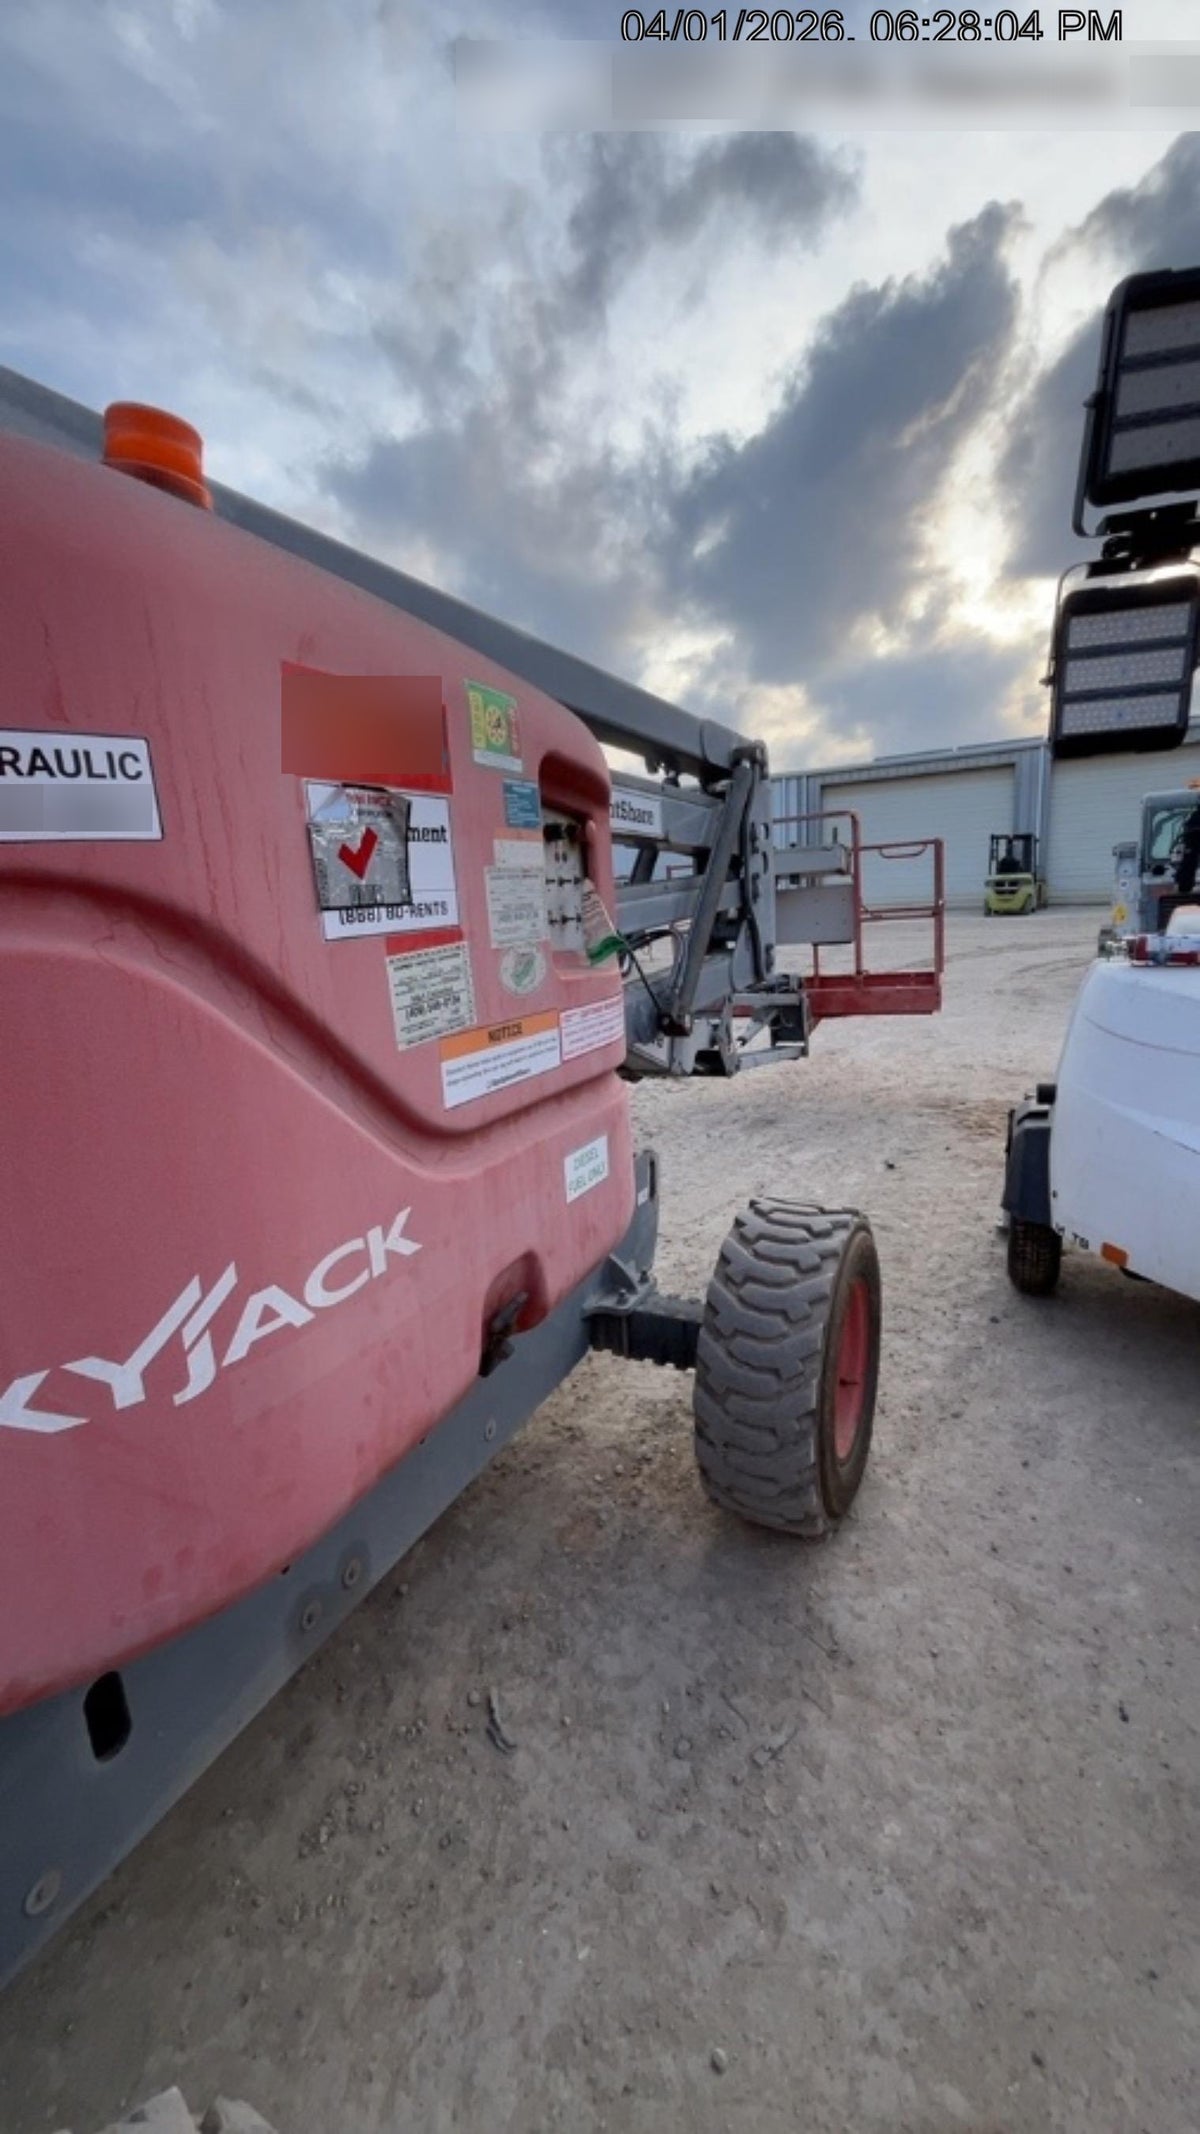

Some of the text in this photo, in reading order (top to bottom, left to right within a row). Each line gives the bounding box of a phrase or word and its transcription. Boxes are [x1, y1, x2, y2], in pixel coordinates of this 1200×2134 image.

[0, 746, 143, 781] RAULIC
[488, 1021, 523, 1044] NOTICE
[573, 1147, 599, 1171] DIESEL
